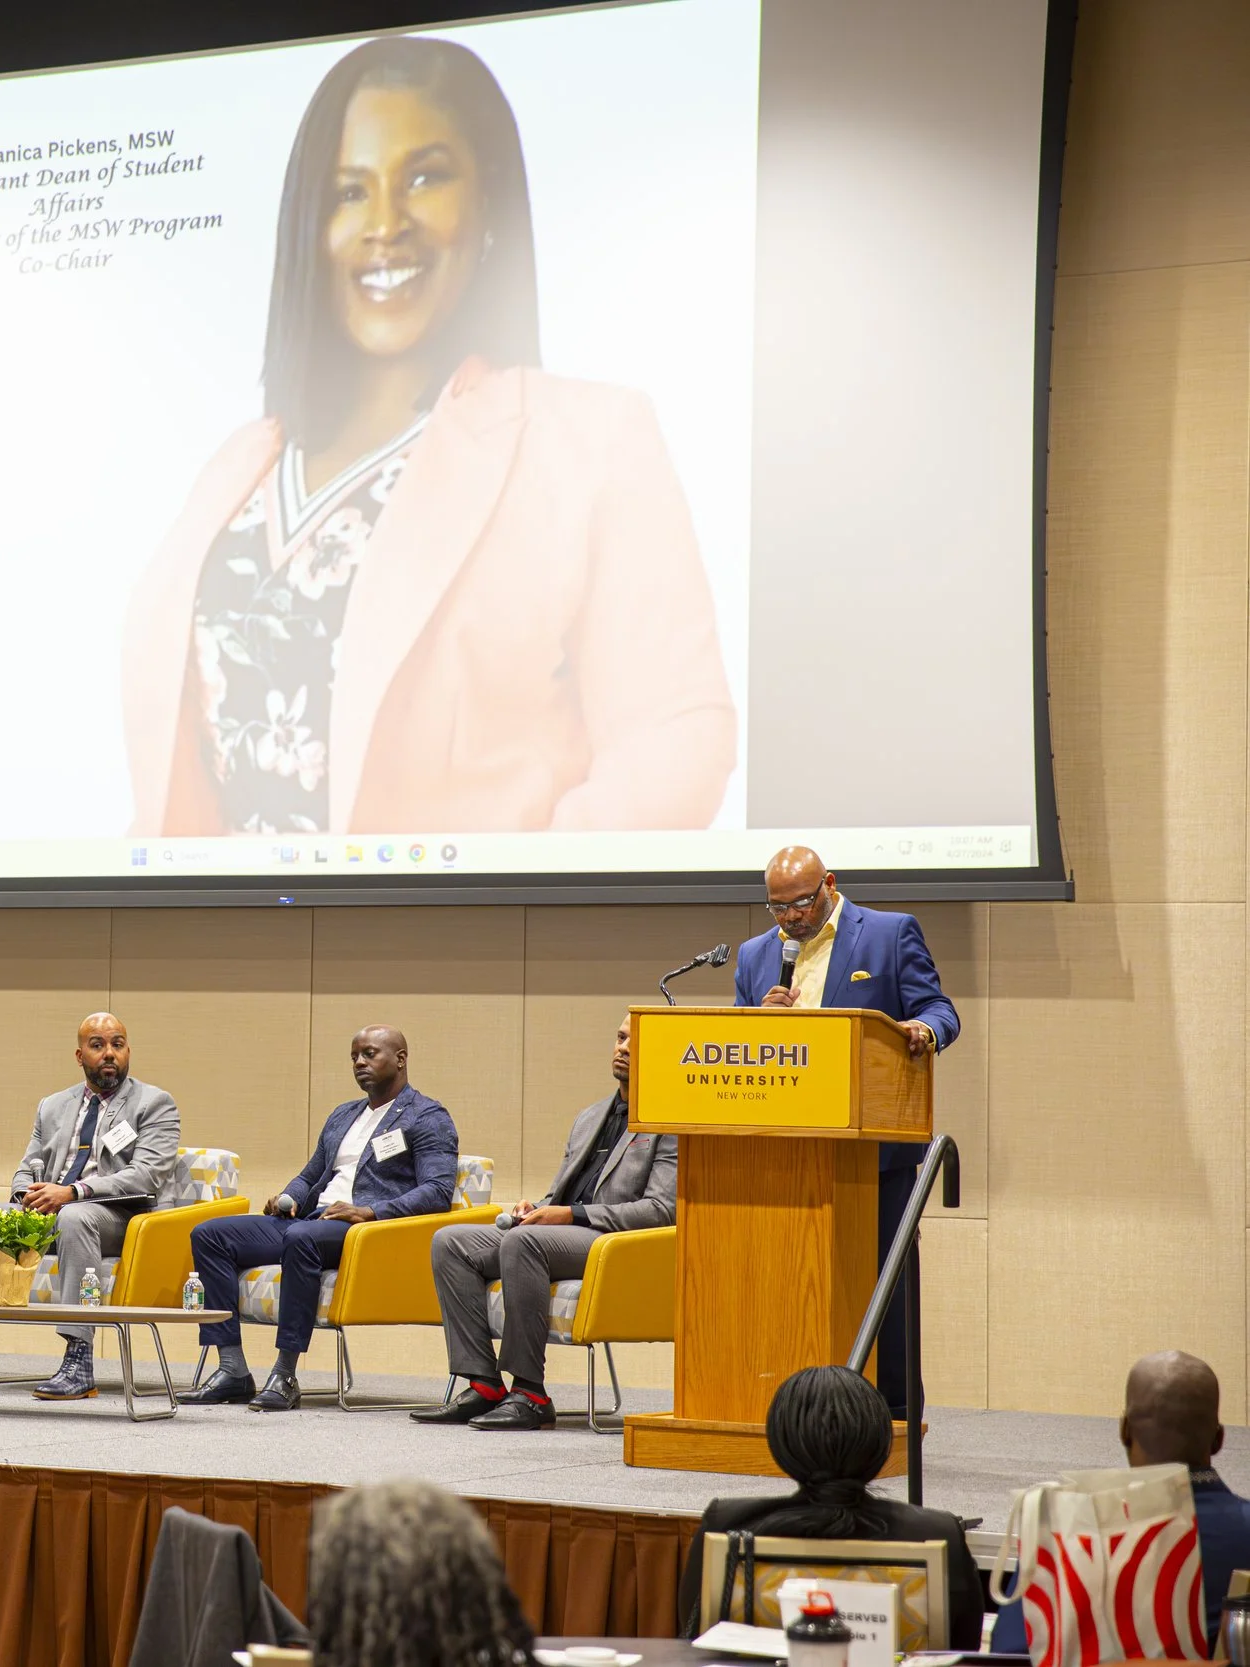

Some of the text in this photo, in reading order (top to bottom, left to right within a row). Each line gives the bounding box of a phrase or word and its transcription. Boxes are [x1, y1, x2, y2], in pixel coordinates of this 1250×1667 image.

[48, 138, 123, 158] Pickens,
[128, 130, 174, 151] MSW
[36, 166, 91, 187] Dean
[97, 158, 122, 188] of
[122, 151, 205, 179] Student
[28, 191, 105, 222] Affairs
[5, 224, 29, 255] of
[31, 221, 62, 246] the
[67, 218, 126, 241] MSW
[128, 213, 224, 240] Program
[18, 249, 114, 275] Co-Chair
[679, 1041, 809, 1068] ADELPHI
[686, 1074, 800, 1087] UNIVERSITY
[716, 1091, 768, 1101] NEW YORK
[839, 1611, 888, 1623] SERVED
